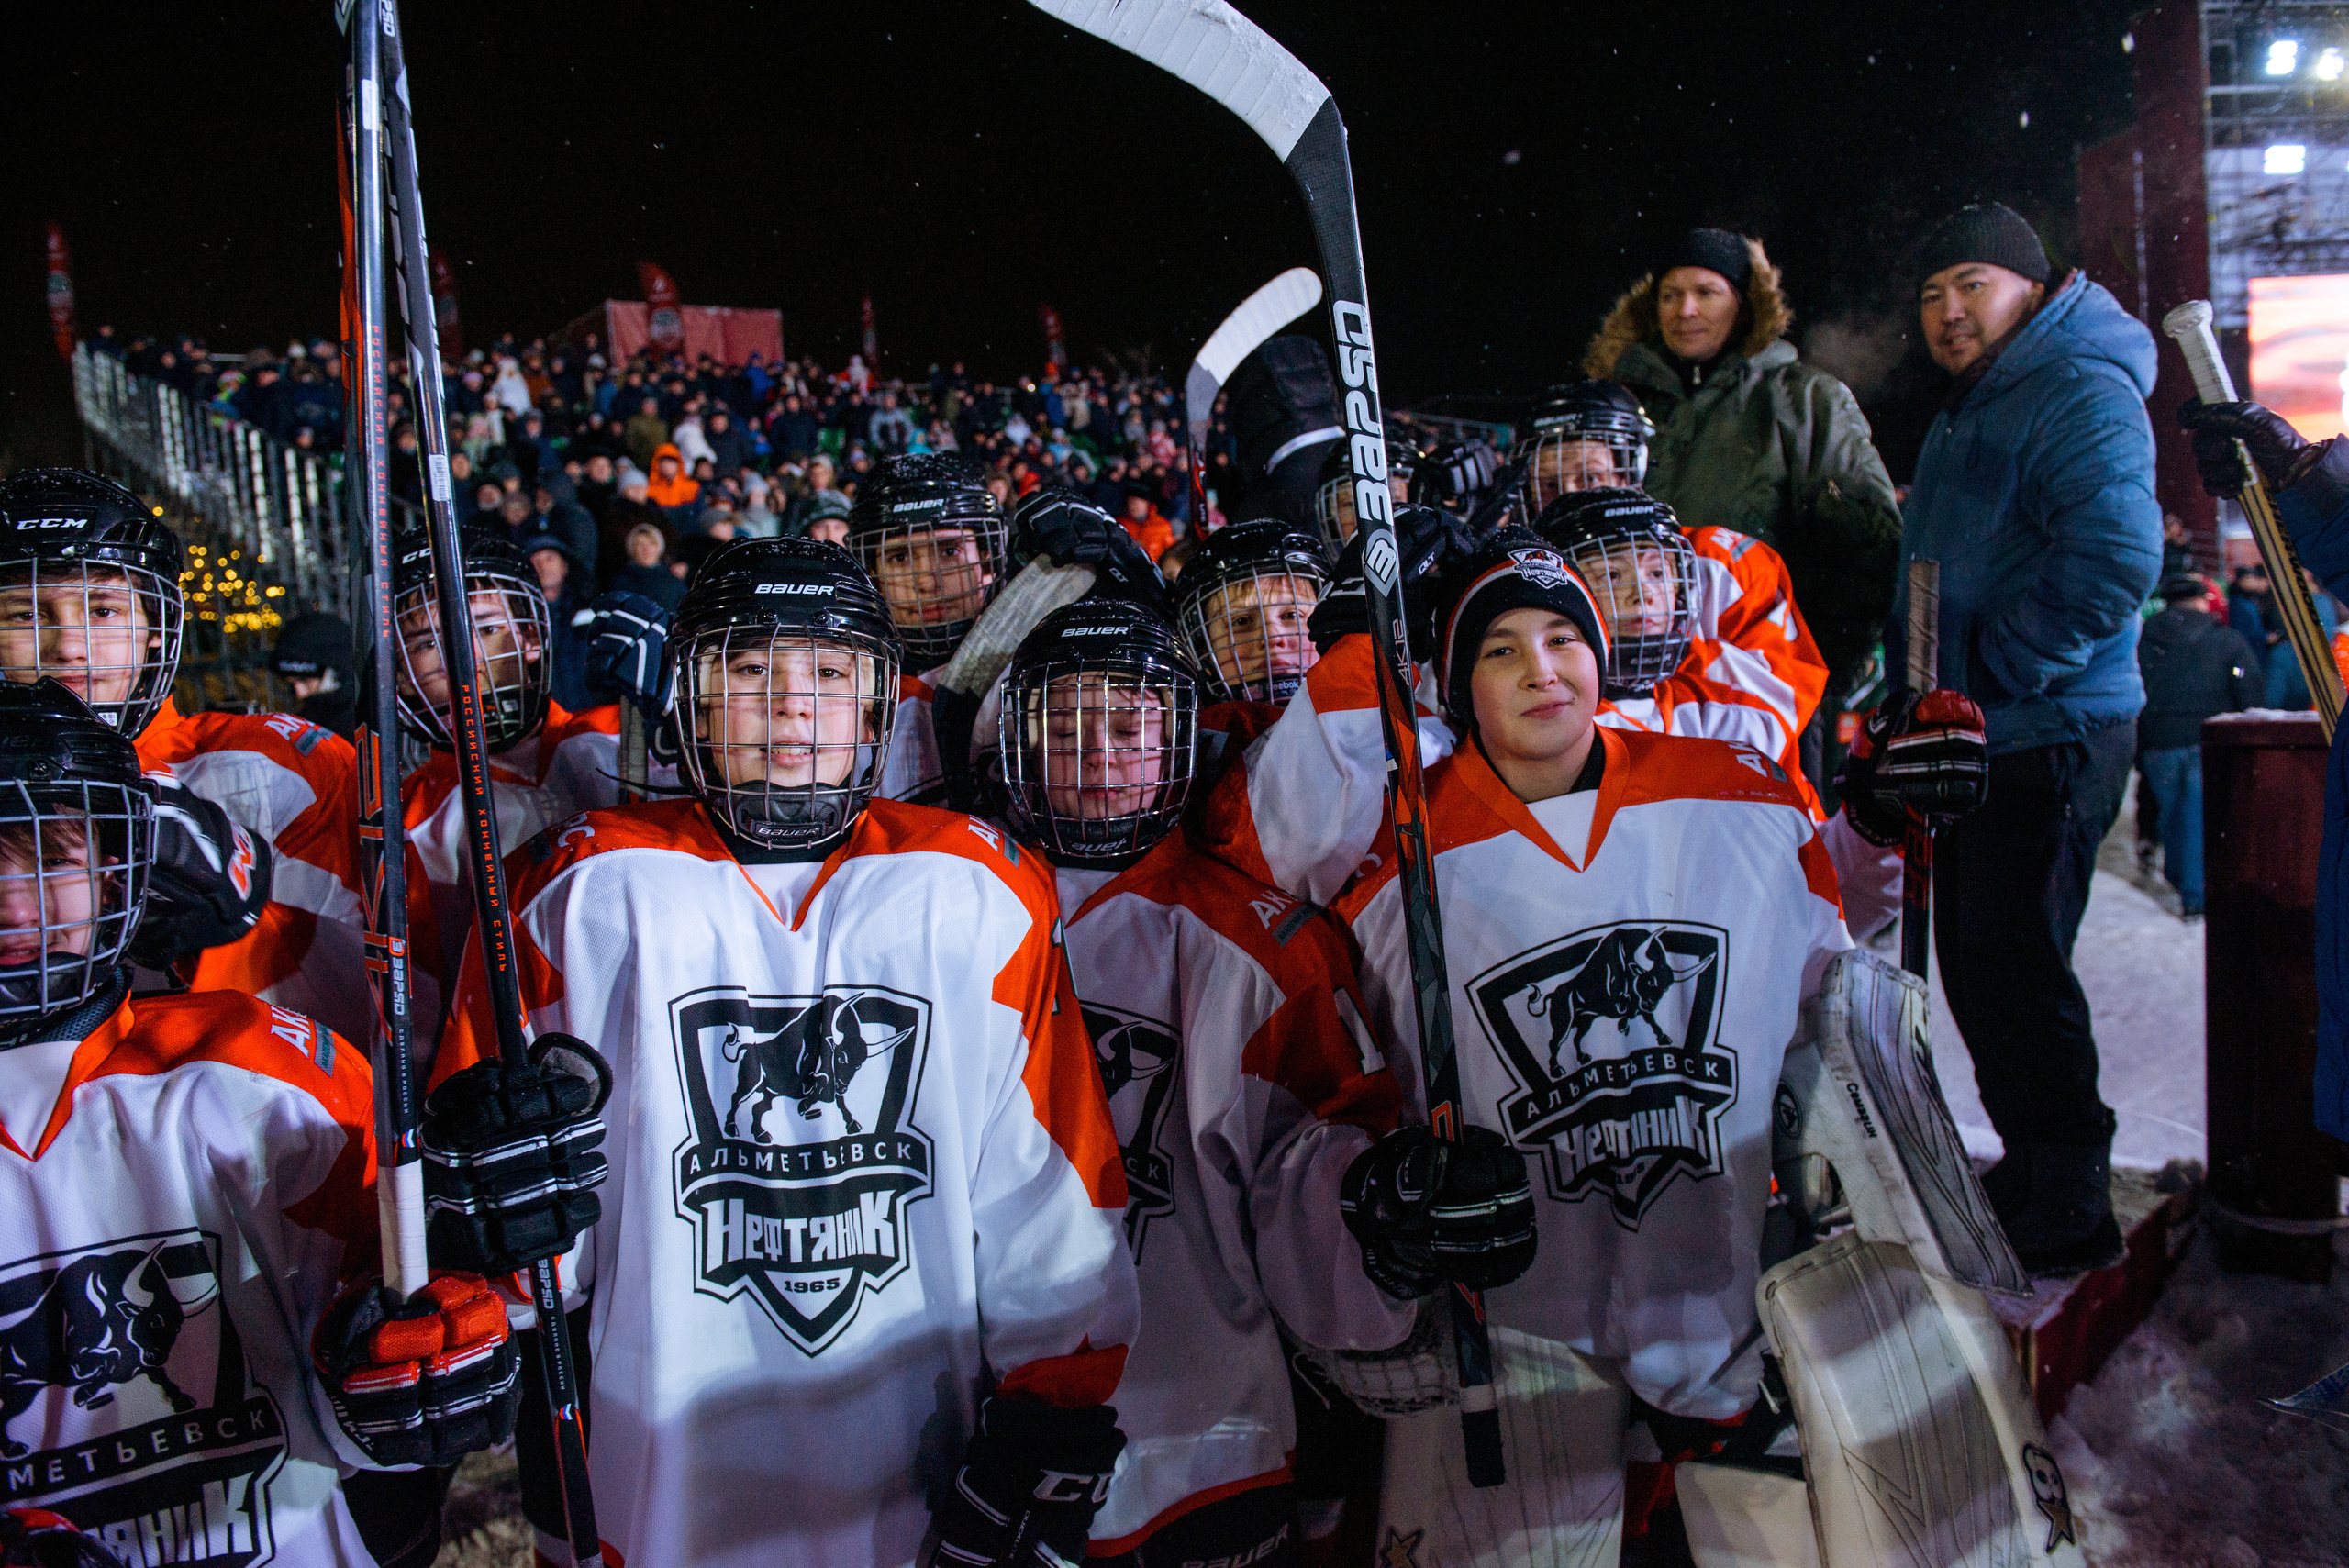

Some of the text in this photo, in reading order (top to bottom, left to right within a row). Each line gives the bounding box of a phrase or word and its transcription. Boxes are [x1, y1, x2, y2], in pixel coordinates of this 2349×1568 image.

[372, 325, 391, 639] РОССИЙСКИЙ ХОККЕЙНЫЙ СТИЛЬ
[892, 498, 945, 513] BAUER
[1603, 506, 1654, 517] BAUER
[16, 517, 88, 531] CCM
[1419, 551, 1435, 574] QLT
[754, 583, 835, 597] BAUER
[1061, 625, 1130, 638] BAUER
[462, 684, 507, 973] РОССИЙСКИЙ ХОККЕЙНЫЙ СТИЛЬ
[758, 828, 819, 836] BAUER
[398, 1029, 406, 1070] СДЕЛАНО
[1525, 1053, 1720, 1120] АЛЬМЕТЬЕВСК
[688, 1142, 913, 1176] АЛЬМЕТЬЕВСК
[701, 1190, 896, 1273] НЕФТЯНИК
[784, 1276, 841, 1294] 1965
[550, 1316, 561, 1352] СДЕЛАНО
[556, 1361, 565, 1391] РОССИИ
